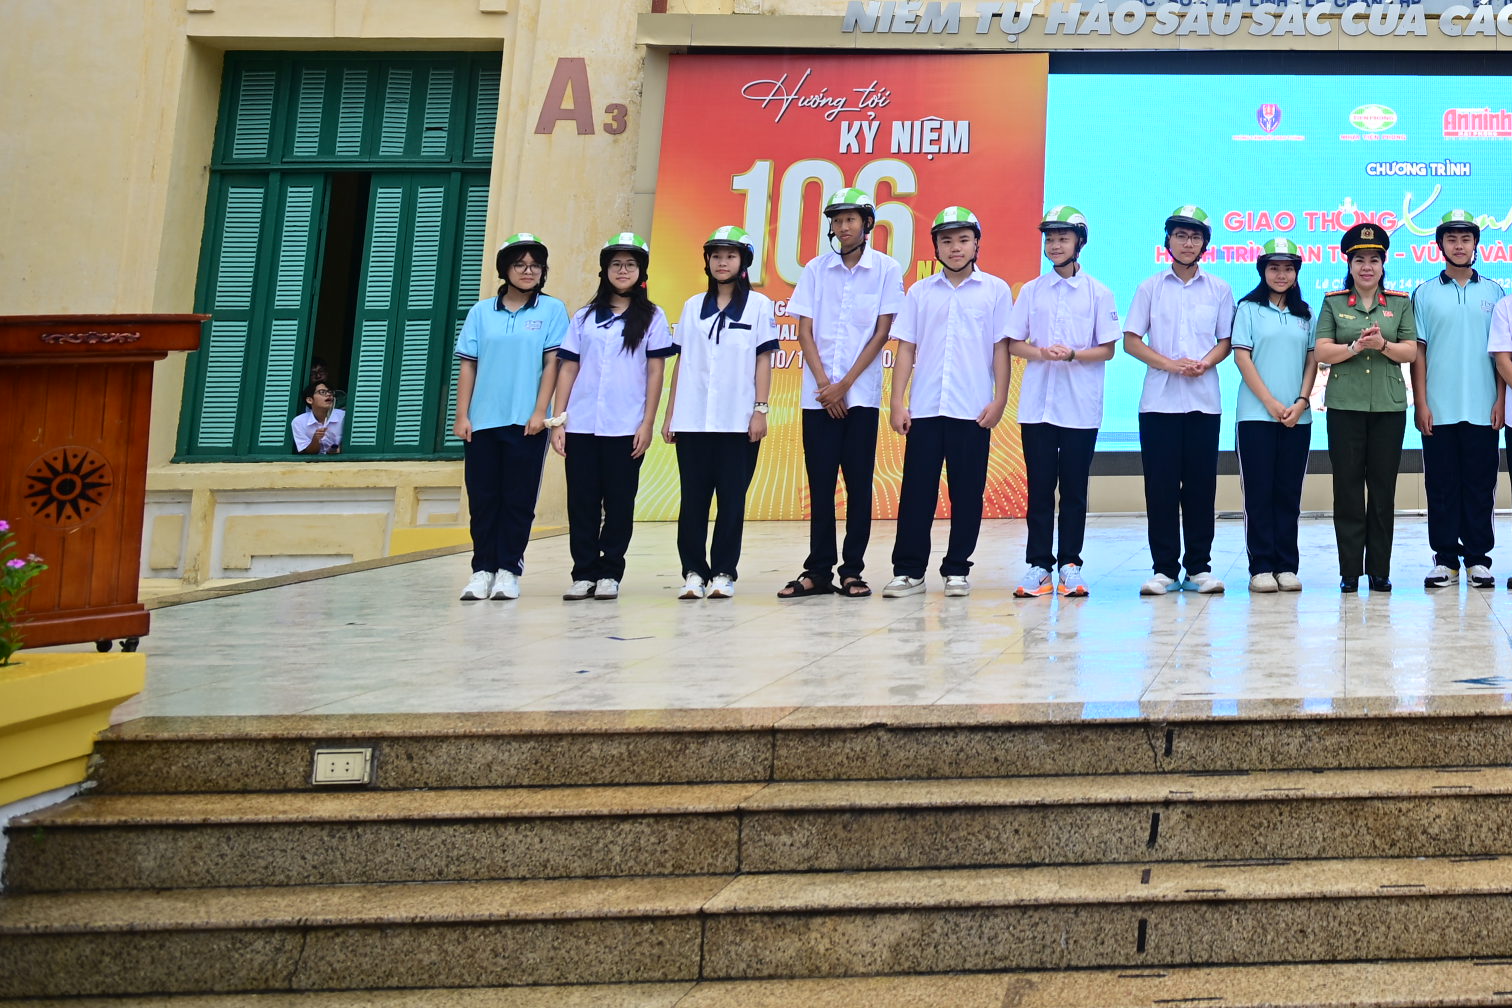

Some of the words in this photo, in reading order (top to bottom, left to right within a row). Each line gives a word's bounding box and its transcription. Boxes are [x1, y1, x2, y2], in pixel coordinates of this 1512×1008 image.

[741, 68, 848, 123] Hướng
[853, 80, 891, 110] tới
[839, 111, 878, 155] KỶ
[890, 115, 970, 160] NIỆM
[1366, 161, 1428, 176] CHƯƠNG
[1429, 159, 1471, 176] TRÌNH
[730, 158, 919, 287] 106
[1224, 210, 1296, 231] GIAO
